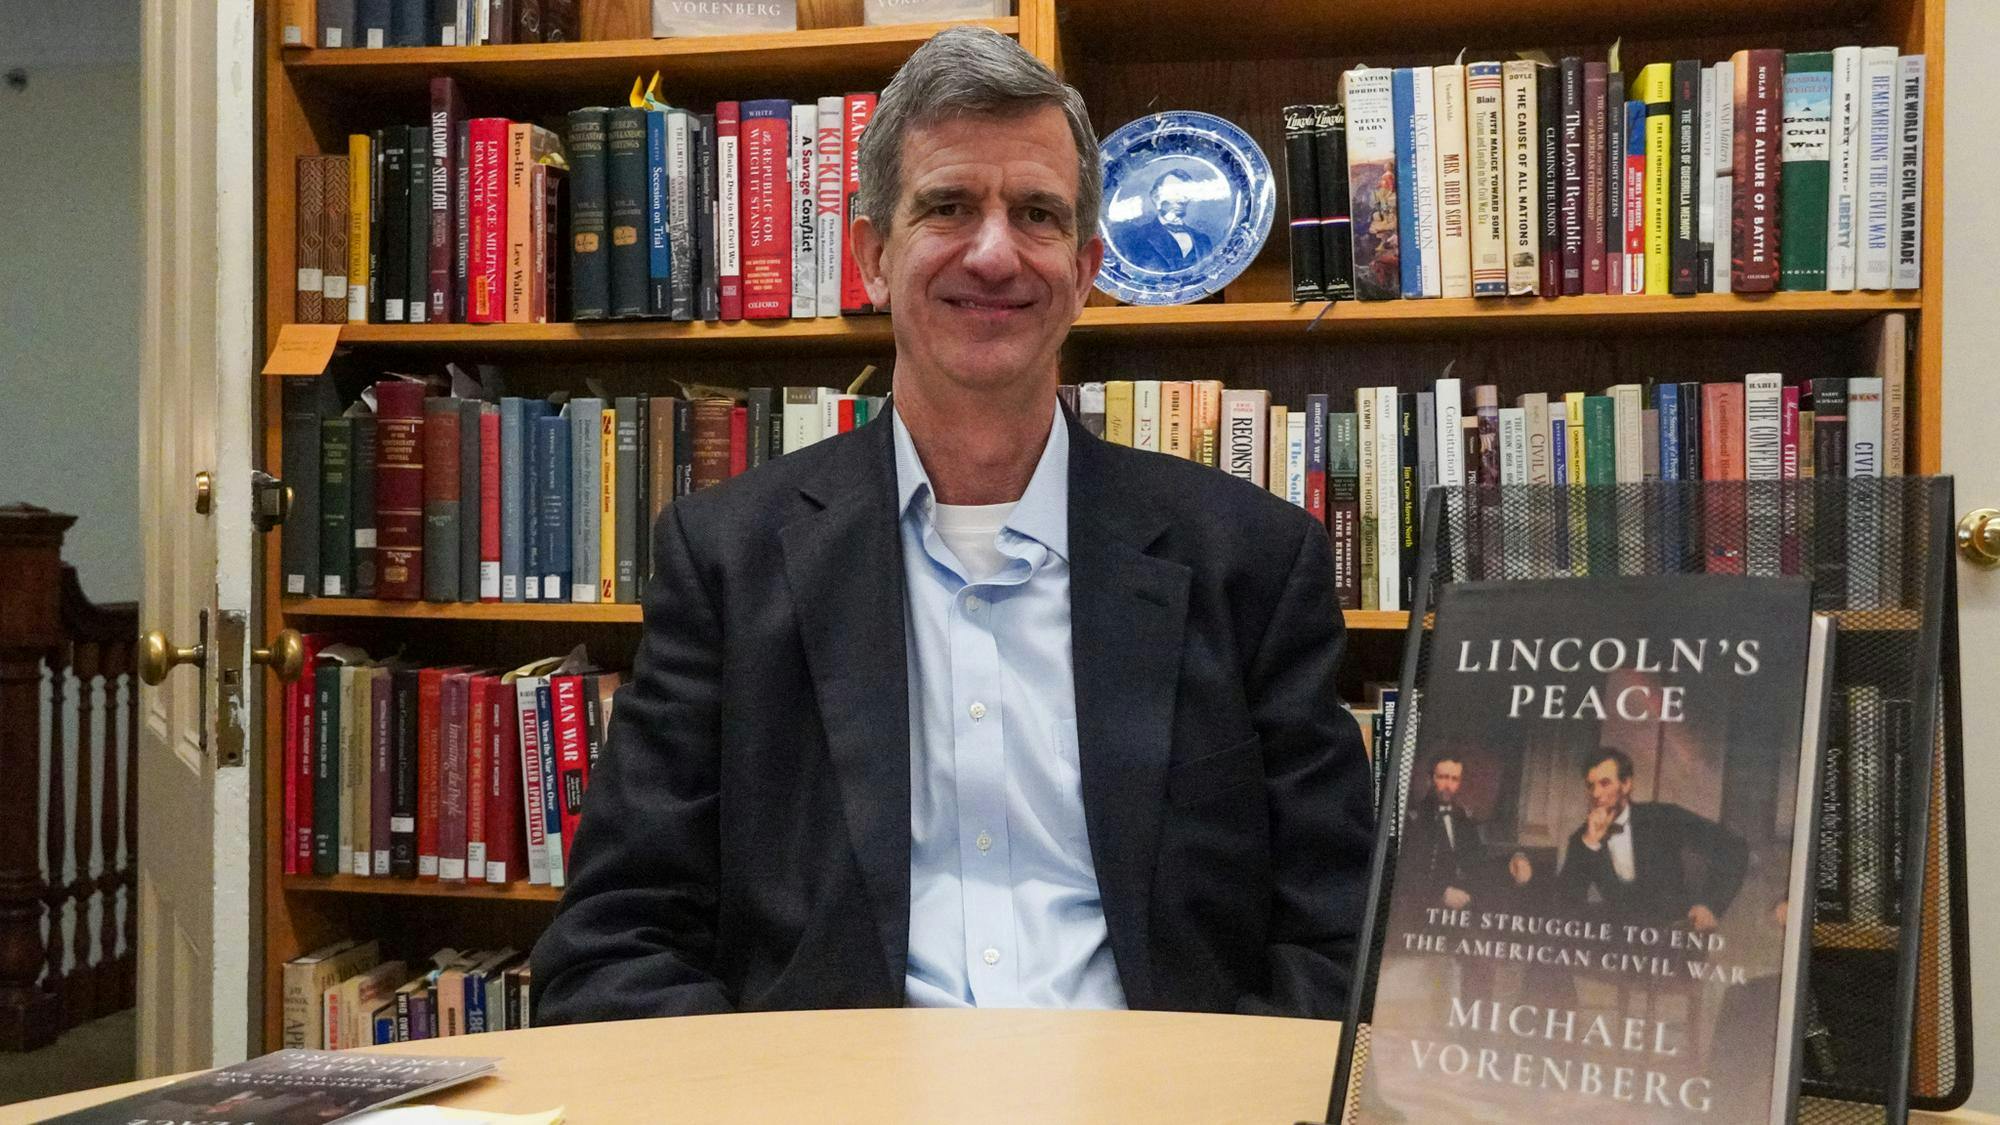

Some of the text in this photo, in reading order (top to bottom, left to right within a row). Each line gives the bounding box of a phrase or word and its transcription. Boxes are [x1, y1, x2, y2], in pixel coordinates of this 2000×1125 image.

[672, 2, 781, 17] VORENBERG
[1476, 96, 1495, 104] Blair
[1758, 66, 1766, 99] NOLAN
[1904, 77, 1919, 100] THE
[432, 112, 448, 158] SHADOW
[1286, 112, 1315, 130] Lincoln
[1314, 110, 1344, 129] Lincoln
[1416, 114, 1430, 151] RACE
[1680, 125, 1691, 152] GHOSTS
[1682, 110, 1692, 124] THE
[1904, 102, 1919, 142] WORLD
[514, 132, 524, 188] Ben-Hur
[1517, 88, 1528, 246] THE CAUSE OF ALL NATIONS
[1680, 154, 1690, 165] OF
[1720, 128, 1730, 163] Matters
[1868, 76, 1890, 249] REMEMBERING THE CIVIL WAR
[1903, 145, 1918, 168] THE
[432, 166, 448, 210] SHILOH
[458, 167, 469, 216] Politician
[474, 140, 485, 207] ROMANTIC
[750, 128, 760, 247] WHICH IT STANDS
[818, 128, 840, 216] KU-KLUX
[1490, 112, 1500, 240] WITH MALICE TOWARD SOME
[1546, 128, 1556, 236] CLAIMING THE UNION
[1562, 112, 1580, 254] The Loyal Republic
[1680, 166, 1691, 206] GUERRILLA
[1753, 108, 1766, 263] THE ALLURE OF BATTLE
[1902, 169, 1916, 200] CIVIL
[652, 166, 664, 249] Secession on Trial
[726, 142, 736, 268] Defining Duty in the Civil War
[762, 148, 773, 242] REPUBLIC FOR
[799, 136, 813, 253] A Savage Conflict
[1444, 154, 1462, 238] MRS. DRED SCOTT
[1901, 202, 1916, 228] WAR
[459, 218, 468, 229] in
[486, 140, 498, 295] LEW WALLACE: MILITANT
[1418, 186, 1433, 250] REUNION
[1680, 207, 1690, 240] MEMORY
[1837, 194, 1852, 248] LIBERTY
[457, 232, 468, 278] Uniform
[1900, 230, 1915, 265] MADE
[512, 243, 522, 315] Lew Wallace
[1364, 400, 1372, 430] GLYMPH
[1720, 400, 1728, 456] Constitutional
[1750, 397, 1778, 421] THE
[1891, 384, 1901, 468] THE BROADSIDES
[1170, 422, 1179, 450] WILLIAMS
[1290, 440, 1302, 467] The
[1314, 402, 1322, 464] america's war
[1446, 406, 1457, 476] Constitution
[1530, 433, 1546, 472] CIVIL
[1668, 416, 1679, 480] Strength People
[1364, 459, 1372, 470] OF
[1346, 510, 1352, 520] IN
[1365, 489, 1373, 517] HOUSE
[1366, 530, 1374, 568] BONDAGE
[1405, 526, 1413, 548] North
[1335, 542, 1343, 588] ENEMIES
[1346, 578, 1352, 588] OF
[1456, 636, 1761, 676] LINCOLN'S
[559, 682, 578, 761] KLAN WAR
[1507, 684, 1688, 723] PEACE
[544, 756, 552, 774] War
[590, 742, 598, 760] THE
[525, 718, 543, 844] PLACE CALLED APPOMATTOX
[1426, 908, 1726, 953] THE STRUGGLE TO END
[1404, 932, 1748, 986] THE AMERICAN CIVIL WAR
[398, 994, 408, 1042] WHO OWNS
[1446, 998, 1678, 1056] MICHAEL
[1408, 1039, 1713, 1114] VORENBERG
